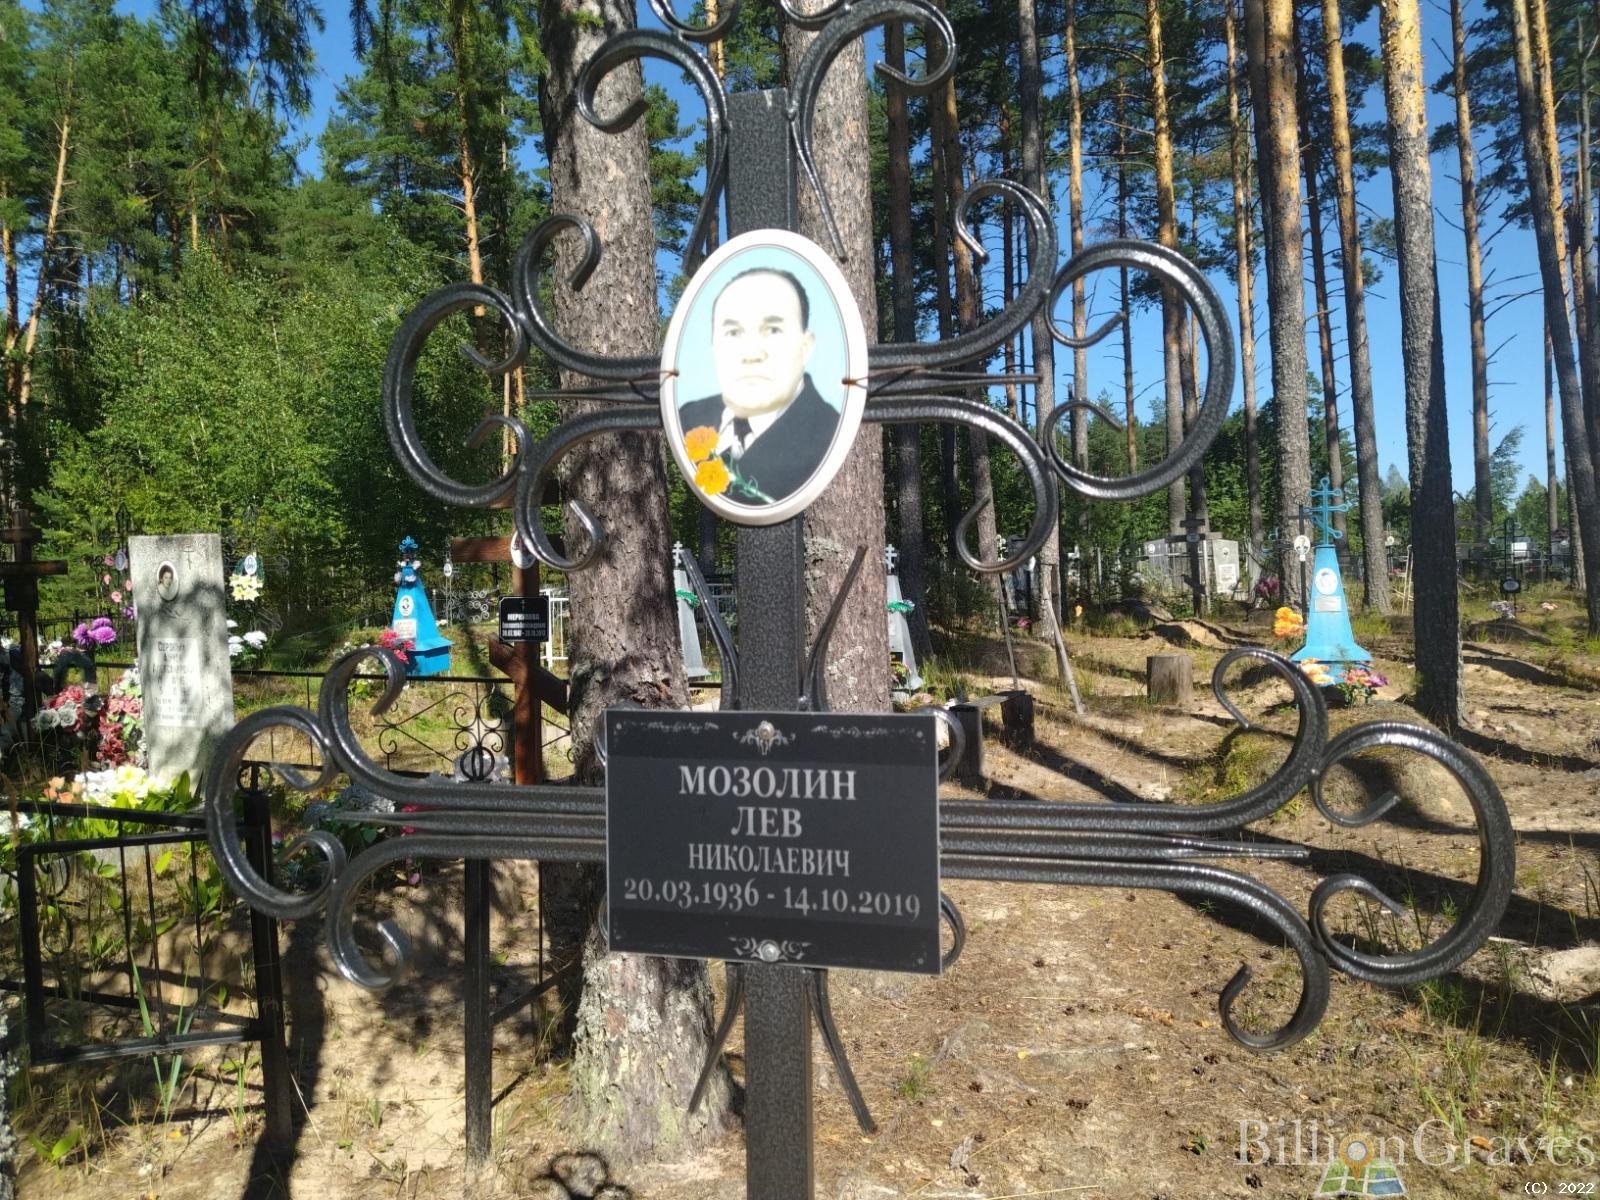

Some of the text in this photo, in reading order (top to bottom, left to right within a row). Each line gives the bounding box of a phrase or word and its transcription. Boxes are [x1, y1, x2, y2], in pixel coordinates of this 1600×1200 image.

[678, 765, 857, 801] МОЗОЛИН
[730, 805, 803, 838] ЛЕВ
[688, 843, 850, 877] НИКОЛАЕВИЧ
[623, 877, 760, 913] 20.03.1936
[783, 886, 921, 922] 14.10.2019
